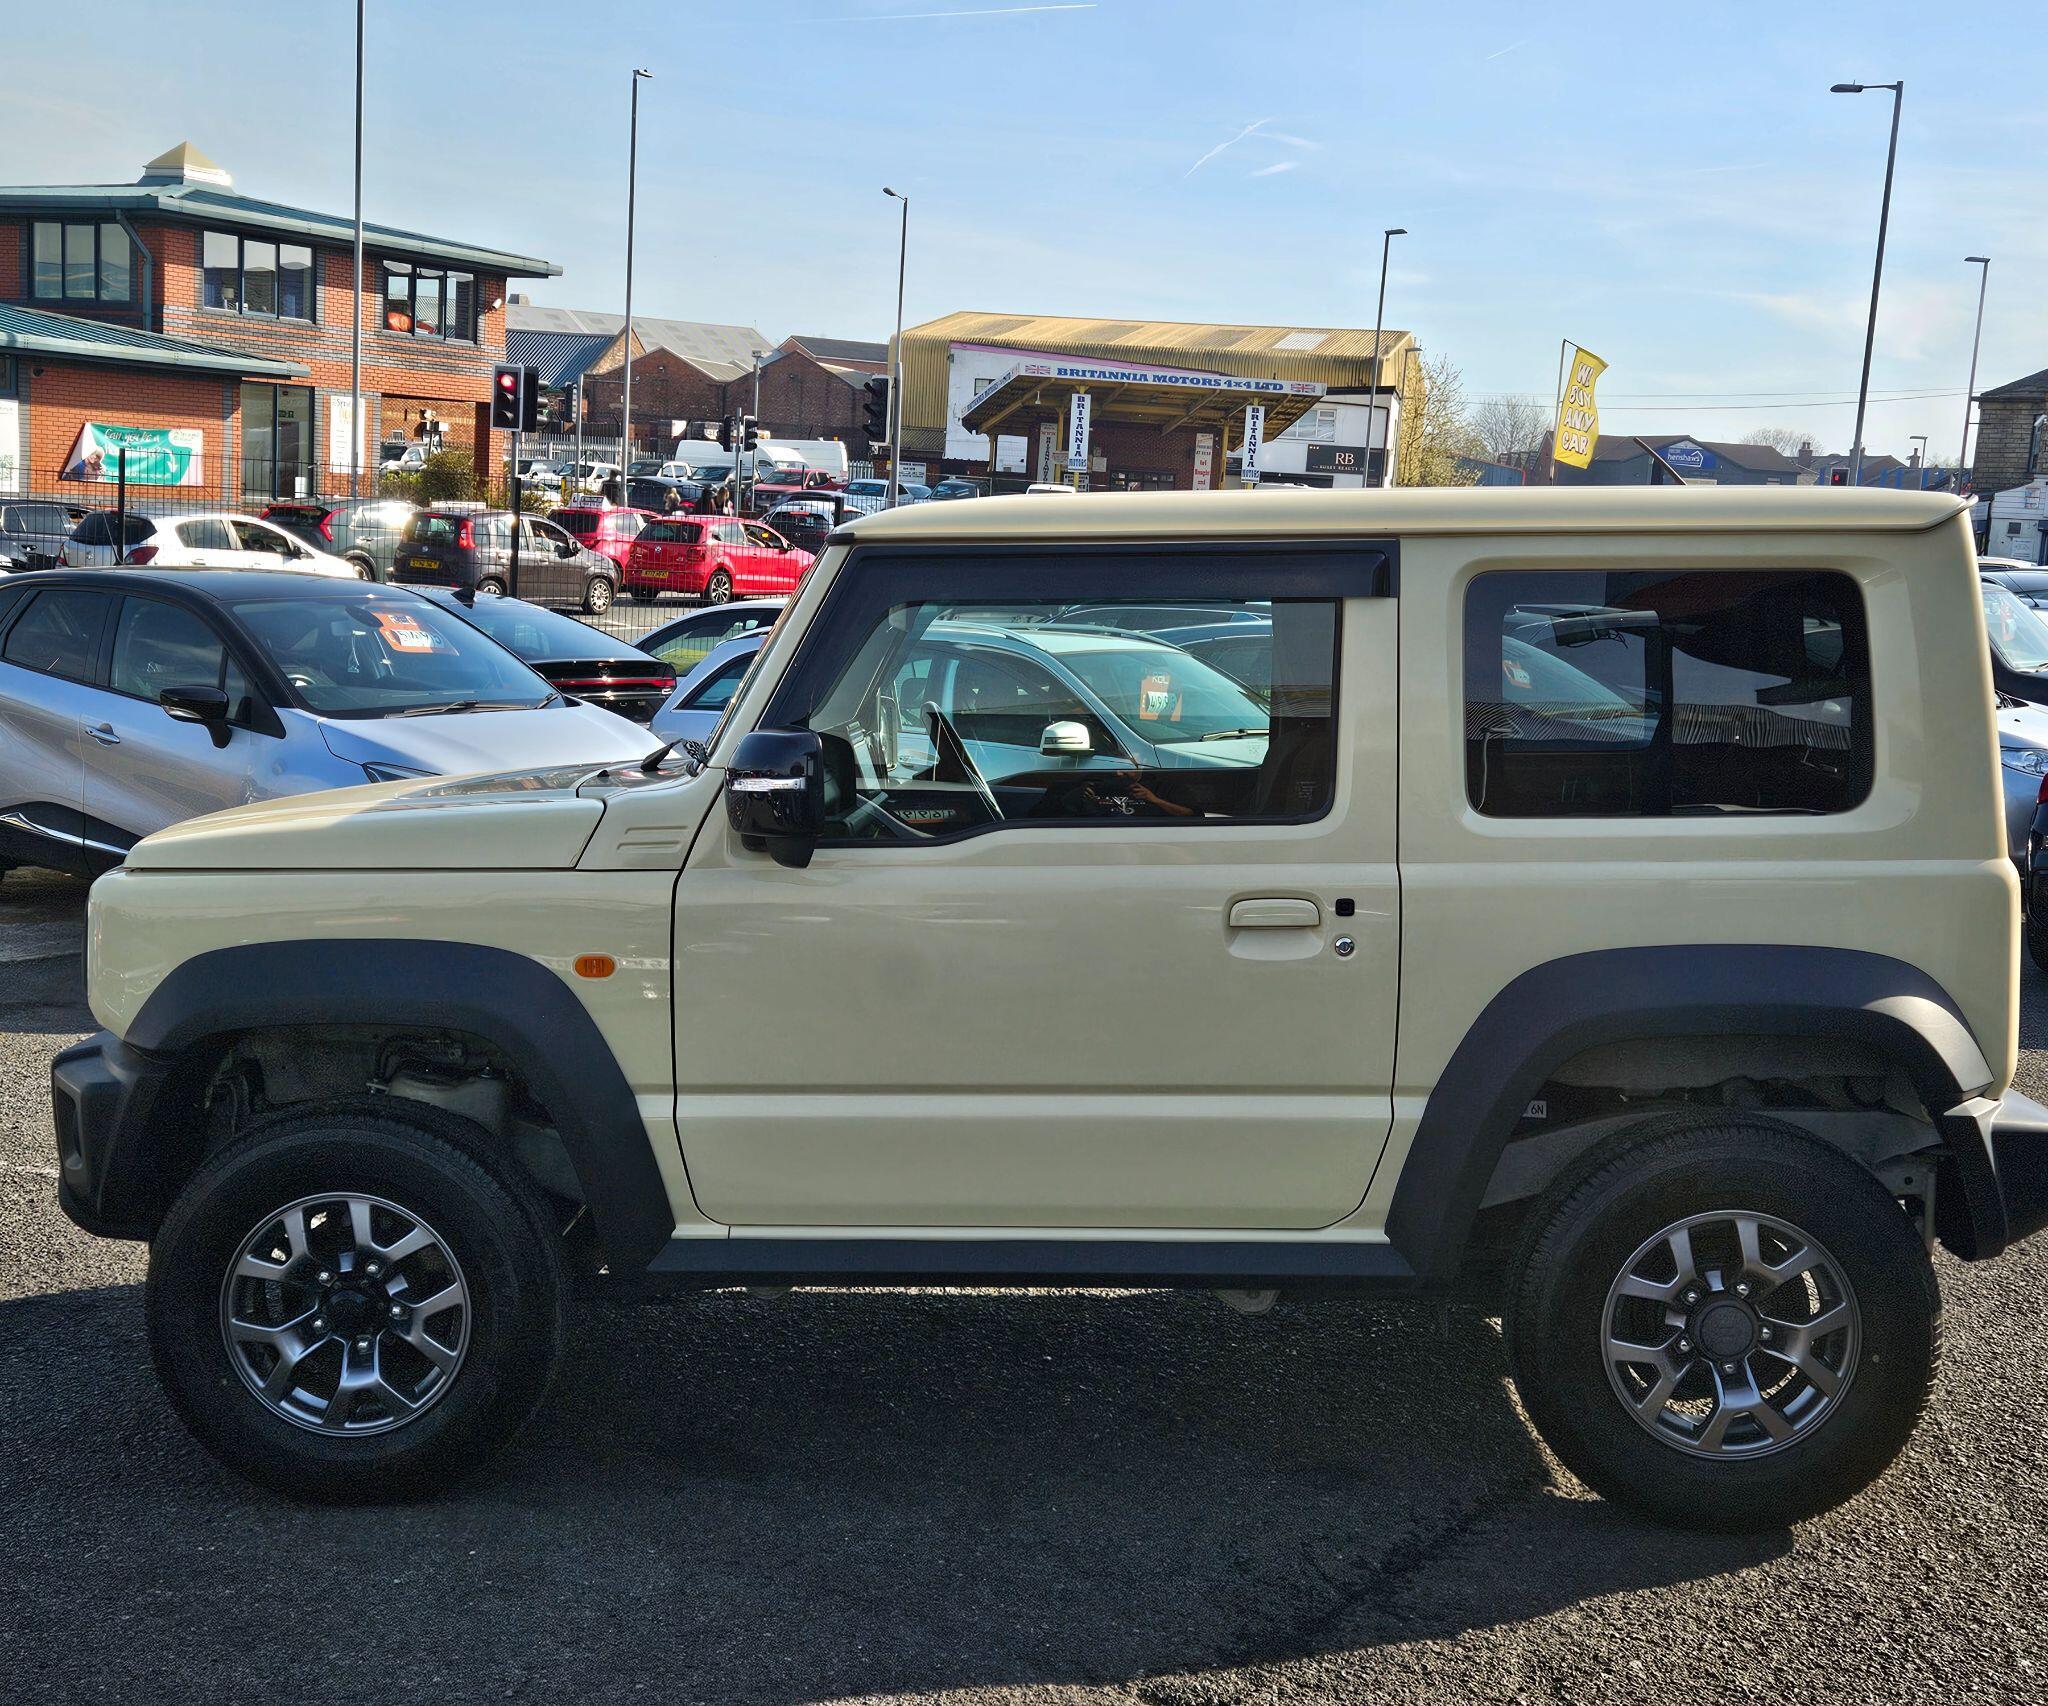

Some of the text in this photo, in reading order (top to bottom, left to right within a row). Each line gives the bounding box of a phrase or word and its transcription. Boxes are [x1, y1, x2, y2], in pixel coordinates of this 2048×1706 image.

[1057, 367, 1284, 391] BRITANNIA MOTORS 4x4 LTD
[1569, 384, 1592, 409] BUY
[1074, 395, 1086, 457] BRITANNIA
[1564, 406, 1595, 433] ANY
[104, 428, 122, 441] Can
[123, 431, 140, 445] you
[1247, 407, 1260, 468] BRITANNIA
[1562, 431, 1589, 455] CAR
[1335, 452, 1355, 465] RB
[1531, 1104, 1544, 1115] 6N
